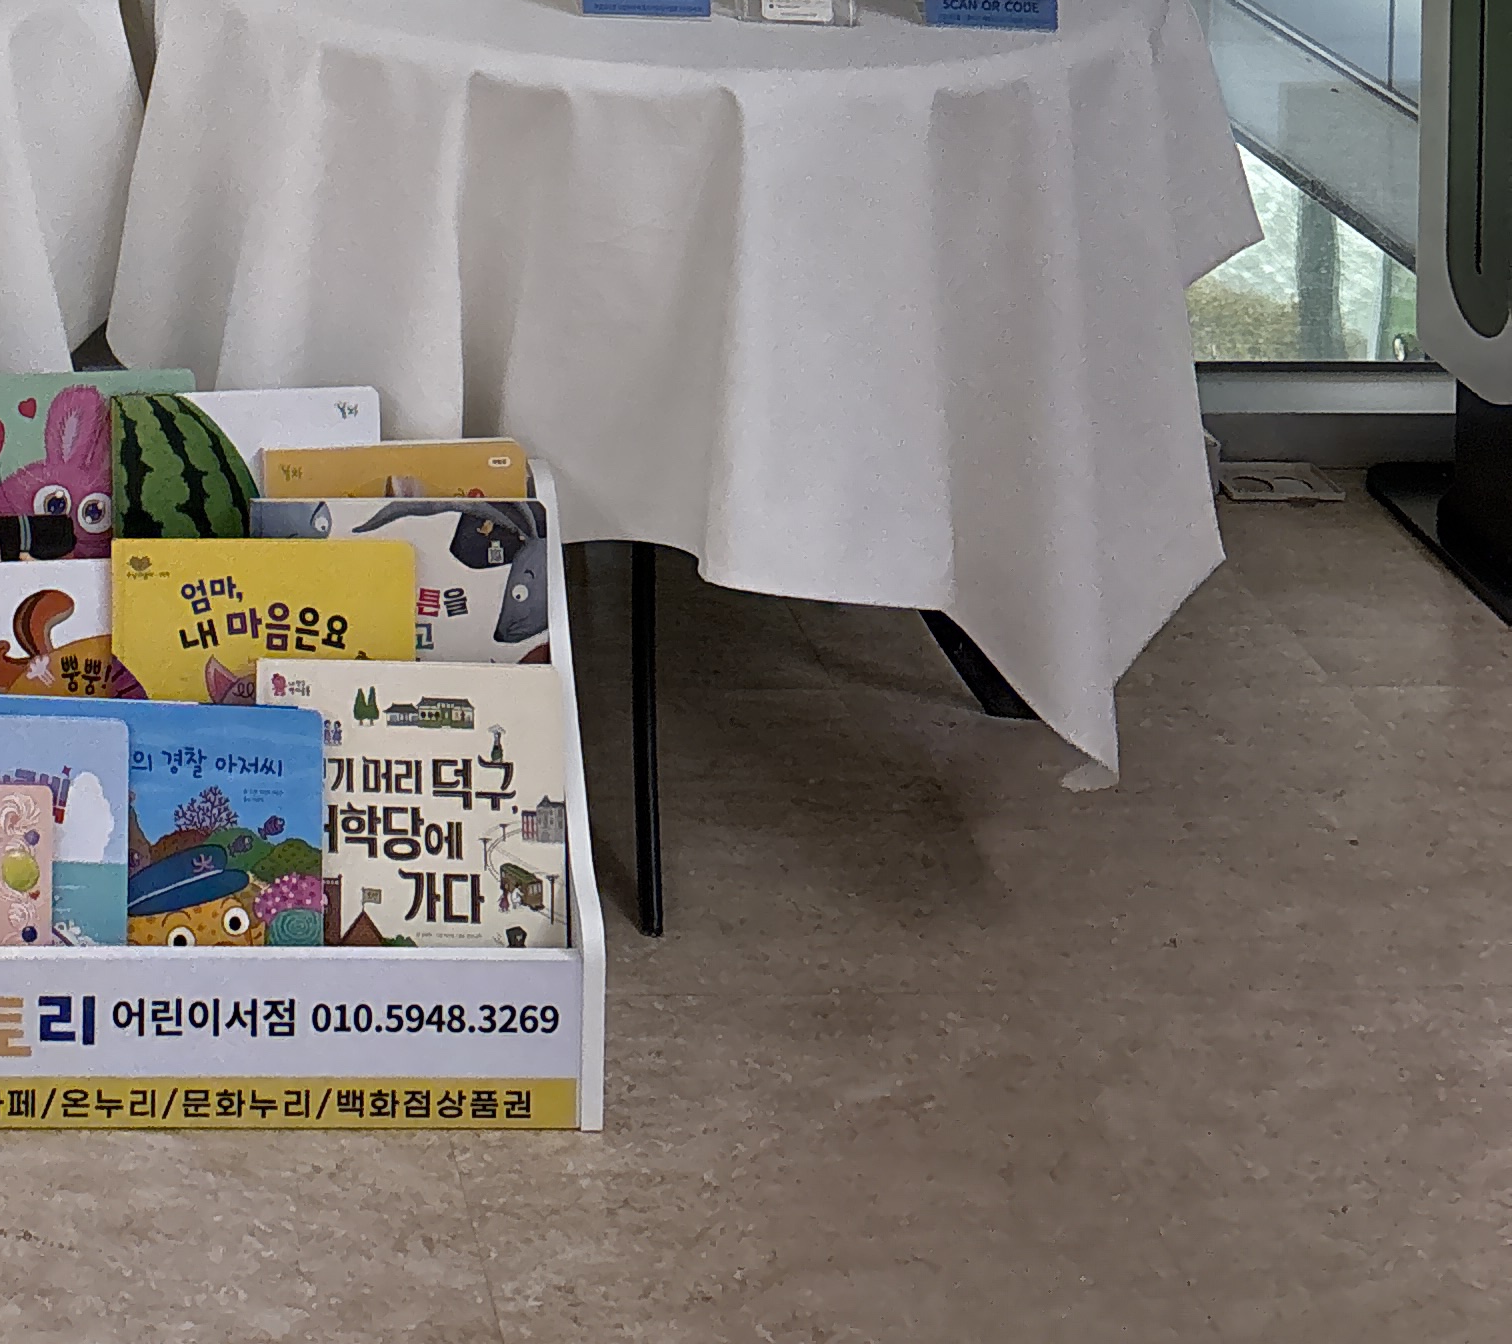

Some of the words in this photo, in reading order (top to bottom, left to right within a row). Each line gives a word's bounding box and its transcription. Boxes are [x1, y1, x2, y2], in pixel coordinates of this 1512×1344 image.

[1004, 0, 1040, 13] CODE
[180, 575, 245, 615] 엄마,
[415, 586, 469, 618] 튼을
[178, 619, 219, 652] 내
[226, 602, 350, 653] 마음은요
[59, 655, 113, 696] 뿡뿡!
[161, 747, 208, 778] 경찰
[215, 755, 283, 778] 아저씨
[323, 757, 356, 793] 기
[361, 755, 423, 795] 머리
[431, 754, 518, 814] 덕구,
[399, 869, 486, 924] 가다
[112, 997, 297, 1037] 어린이서점
[310, 1000, 561, 1036] 010.5948.3269
